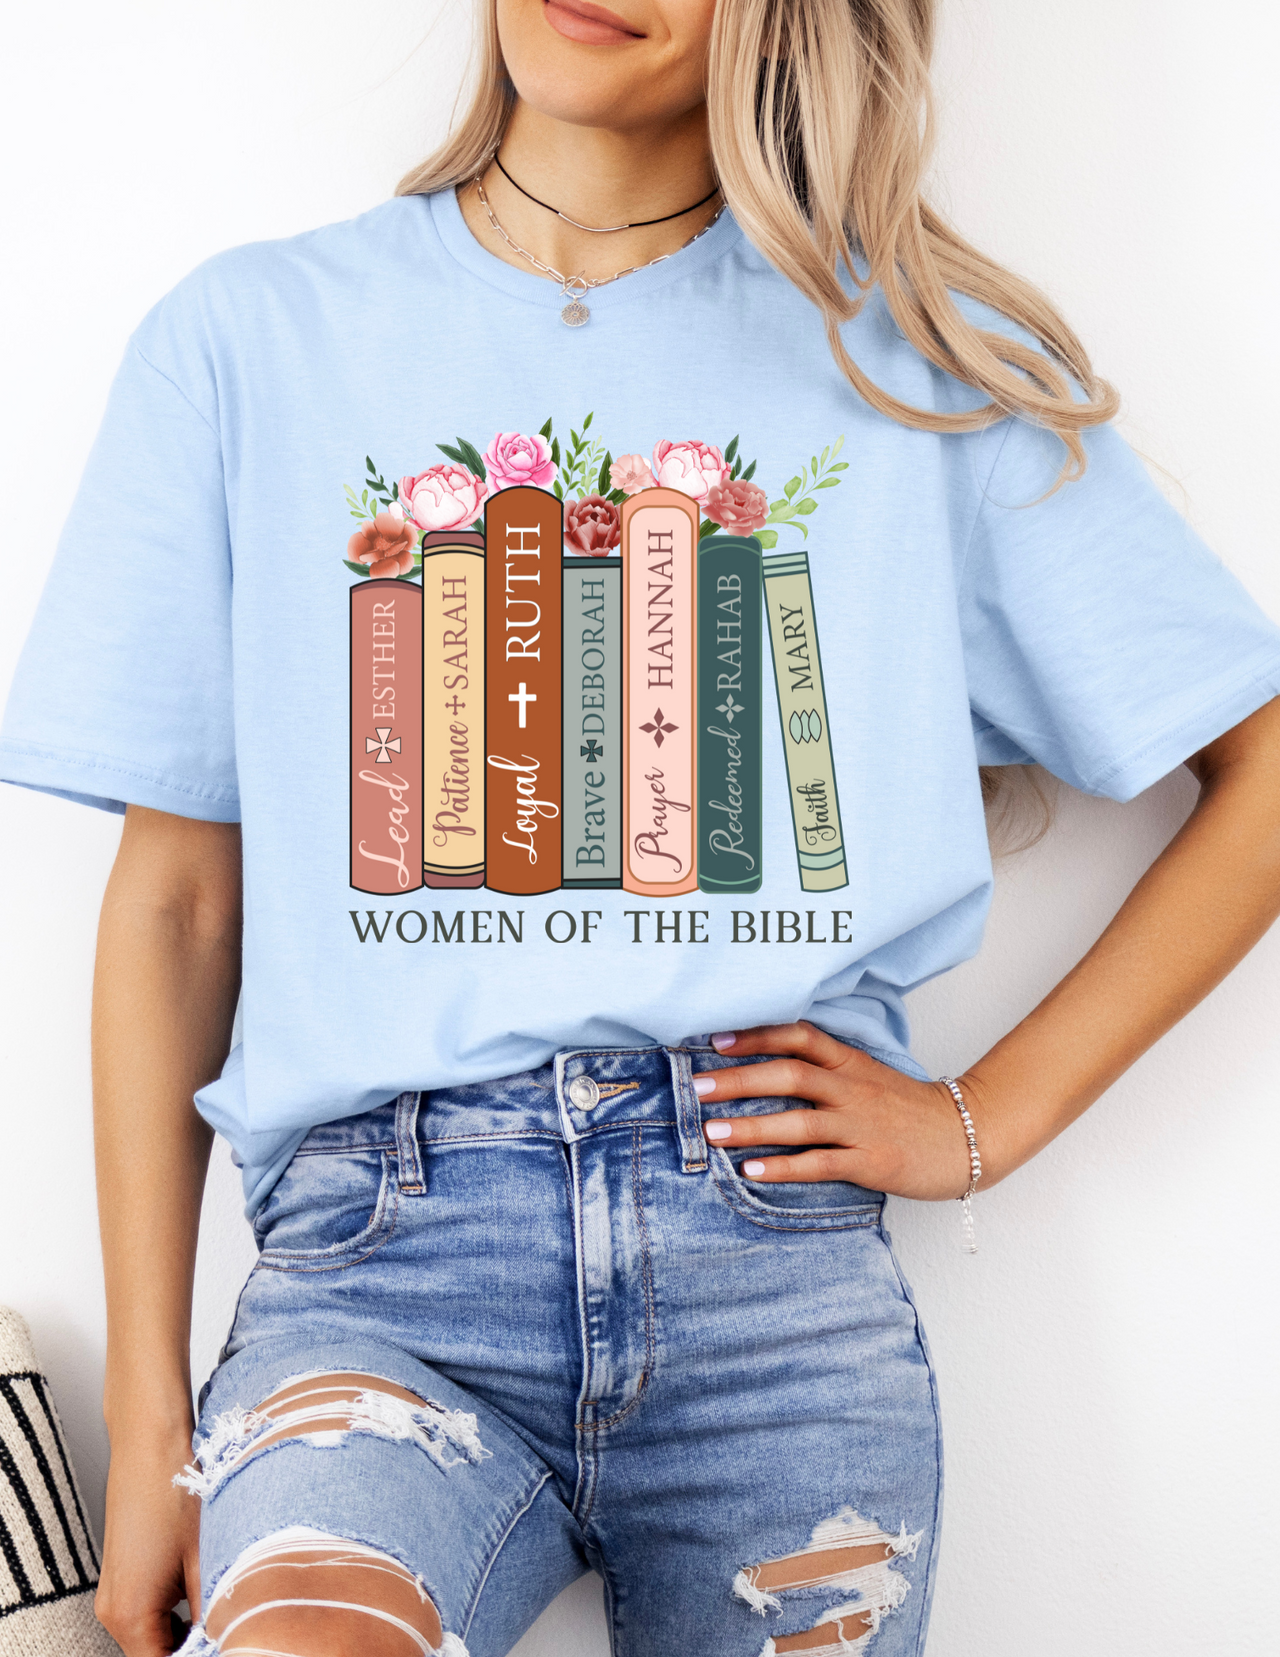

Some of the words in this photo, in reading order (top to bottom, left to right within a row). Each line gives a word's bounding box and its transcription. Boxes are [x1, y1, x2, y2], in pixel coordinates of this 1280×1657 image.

[441, 575, 469, 690] SARAH
[505, 522, 541, 663] RUTH
[647, 529, 674, 690] HANNAH
[717, 573, 742, 692] RAHAB
[780, 604, 814, 692] MARY
[372, 599, 396, 720] ESTHER
[581, 578, 606, 736] DEBORAH
[359, 769, 410, 888] Lead
[432, 720, 476, 848] Patience
[487, 753, 559, 865] Loyal
[575, 771, 606, 868] Brave
[634, 766, 691, 873] Prayer
[708, 725, 755, 871] Redeemed
[801, 778, 837, 847] Faith
[349, 910, 525, 944] WOMEN
[545, 910, 603, 944] OF
[623, 910, 710, 944] THE
[730, 910, 854, 944] BIBLE
